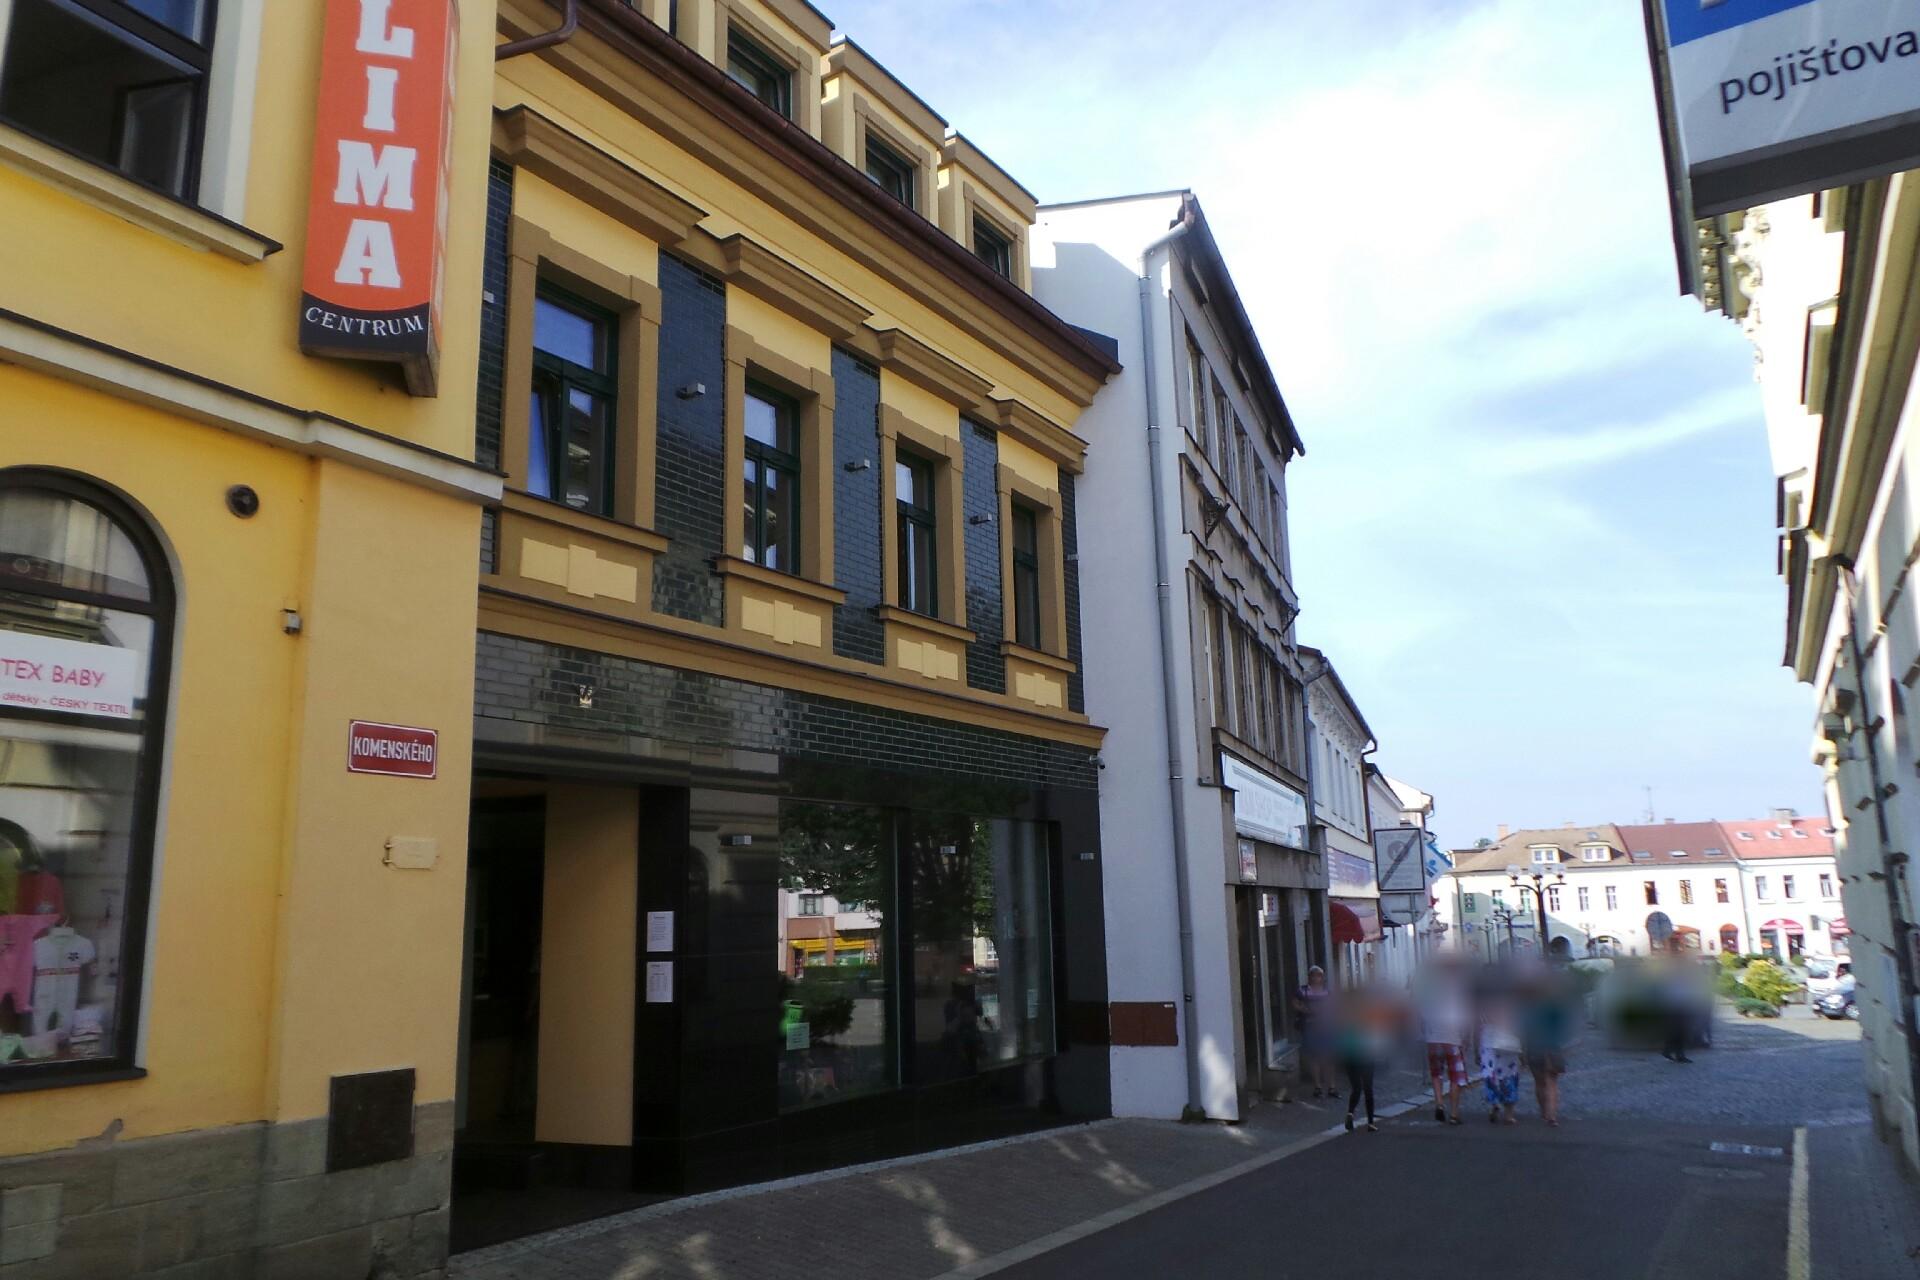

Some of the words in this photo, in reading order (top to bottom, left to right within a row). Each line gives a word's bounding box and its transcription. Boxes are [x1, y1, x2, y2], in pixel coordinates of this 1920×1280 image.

[1719, 30, 1920, 114] pojišťova
[333, 0, 416, 288] LIMA
[305, 306, 424, 336] CENTRUM
[0, 658, 42, 680] TEX
[52, 664, 105, 688] BABY
[93, 702, 129, 714] TEXTIL
[353, 737, 433, 763] KOMENSKÉHO
